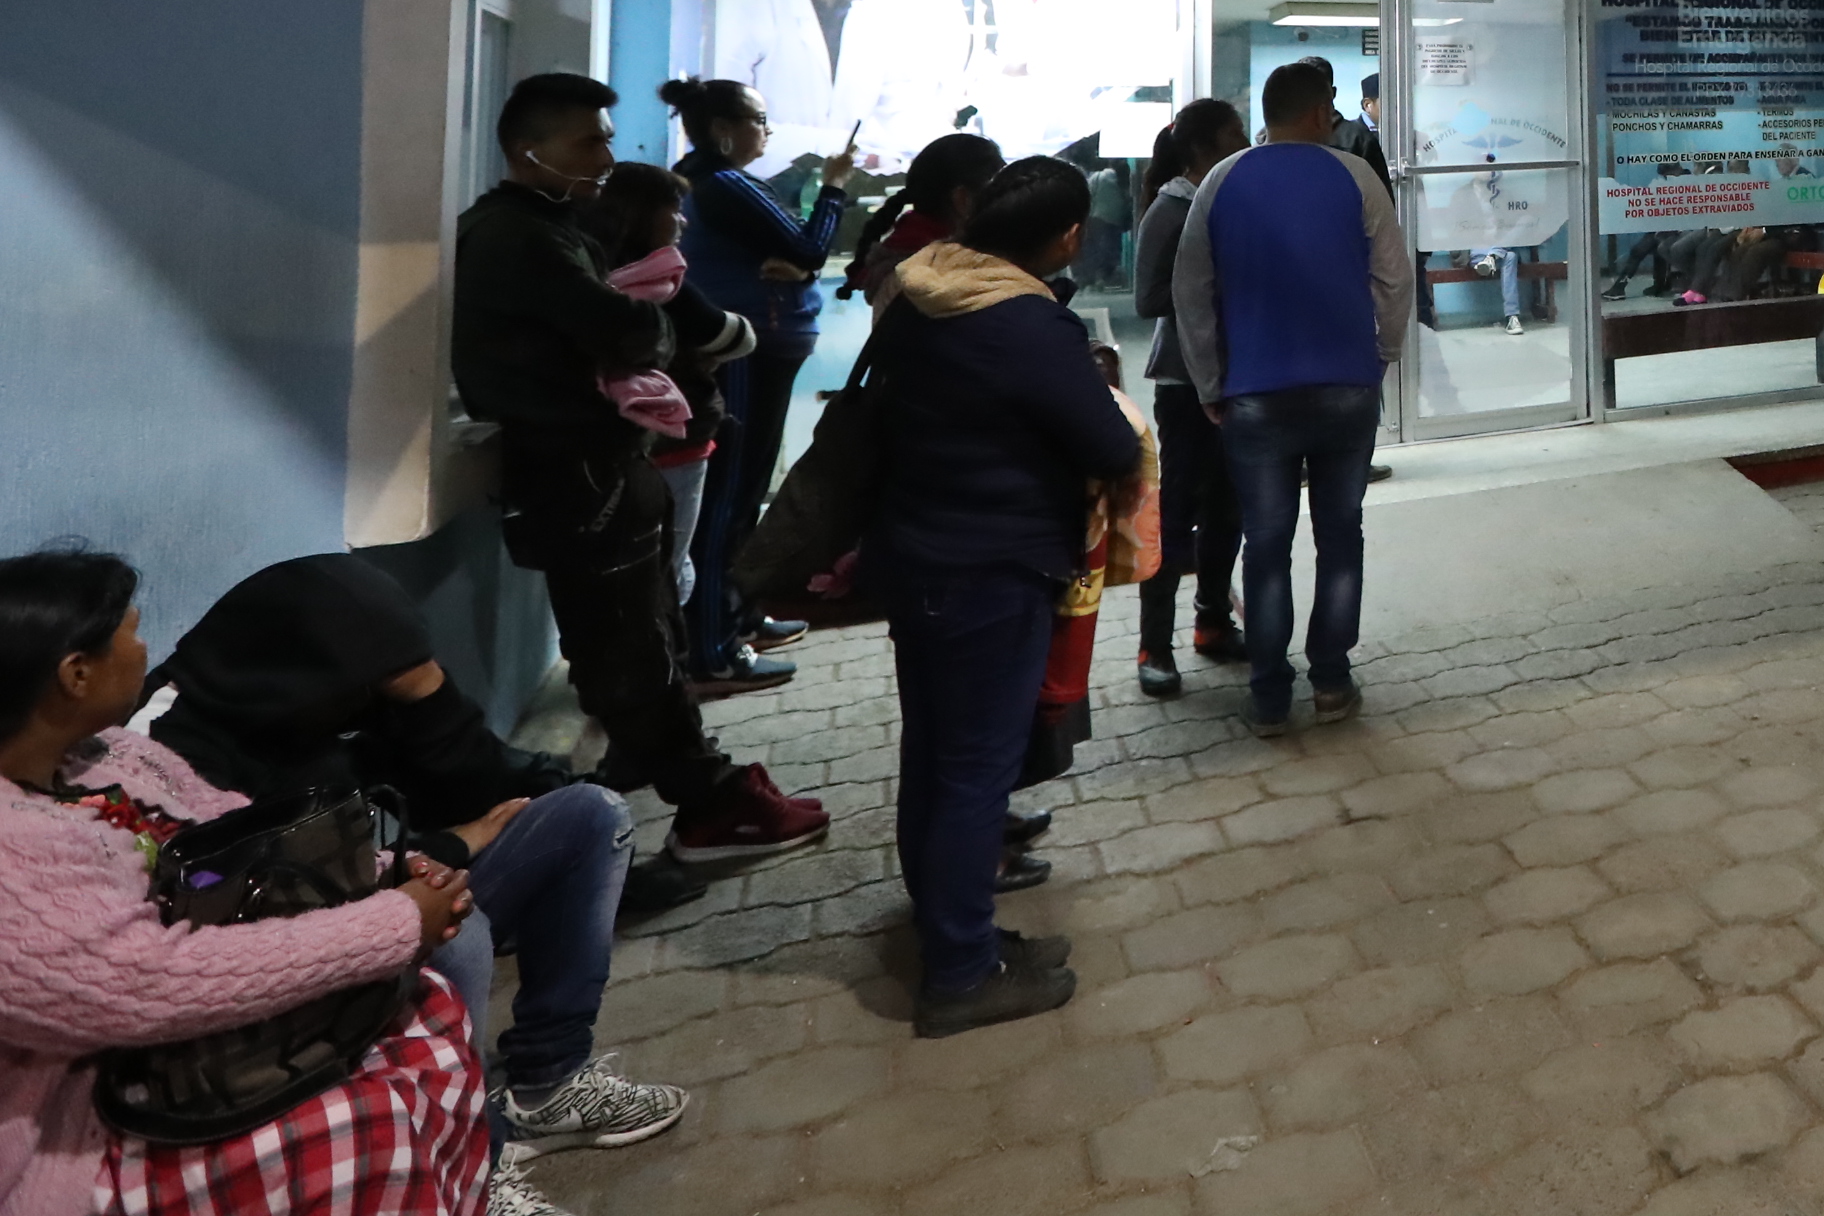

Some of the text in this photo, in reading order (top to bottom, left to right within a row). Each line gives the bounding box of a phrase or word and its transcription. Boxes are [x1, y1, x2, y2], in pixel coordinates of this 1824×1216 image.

[1613, 108, 1660, 119] MOCHILAS
[1670, 108, 1717, 118] CANASTAS
[1613, 121, 1724, 132] PONCHOS Y CHAMARRAS
[1523, 121, 1567, 149] OCCIDENTE
[1763, 131, 1817, 142] DEL PACIENTE
[1627, 156, 1648, 165] HAY
[1650, 154, 1680, 163] COMO
[1680, 153, 1692, 162] EL
[1694, 152, 1727, 162] ORDEN
[1729, 151, 1754, 160] PARA
[1755, 148, 1797, 159] ENSEÑAR
[1797, 149, 1806, 158] A
[1607, 181, 1770, 198] HOSPITAL REGIONAL DE OCCIDENTE
[1508, 200, 1528, 211] HRO
[1628, 193, 1752, 208] NO SE HACE RESPONSABLE
[1625, 203, 1756, 219] POR OBJETOS EXTRAVIADOS
